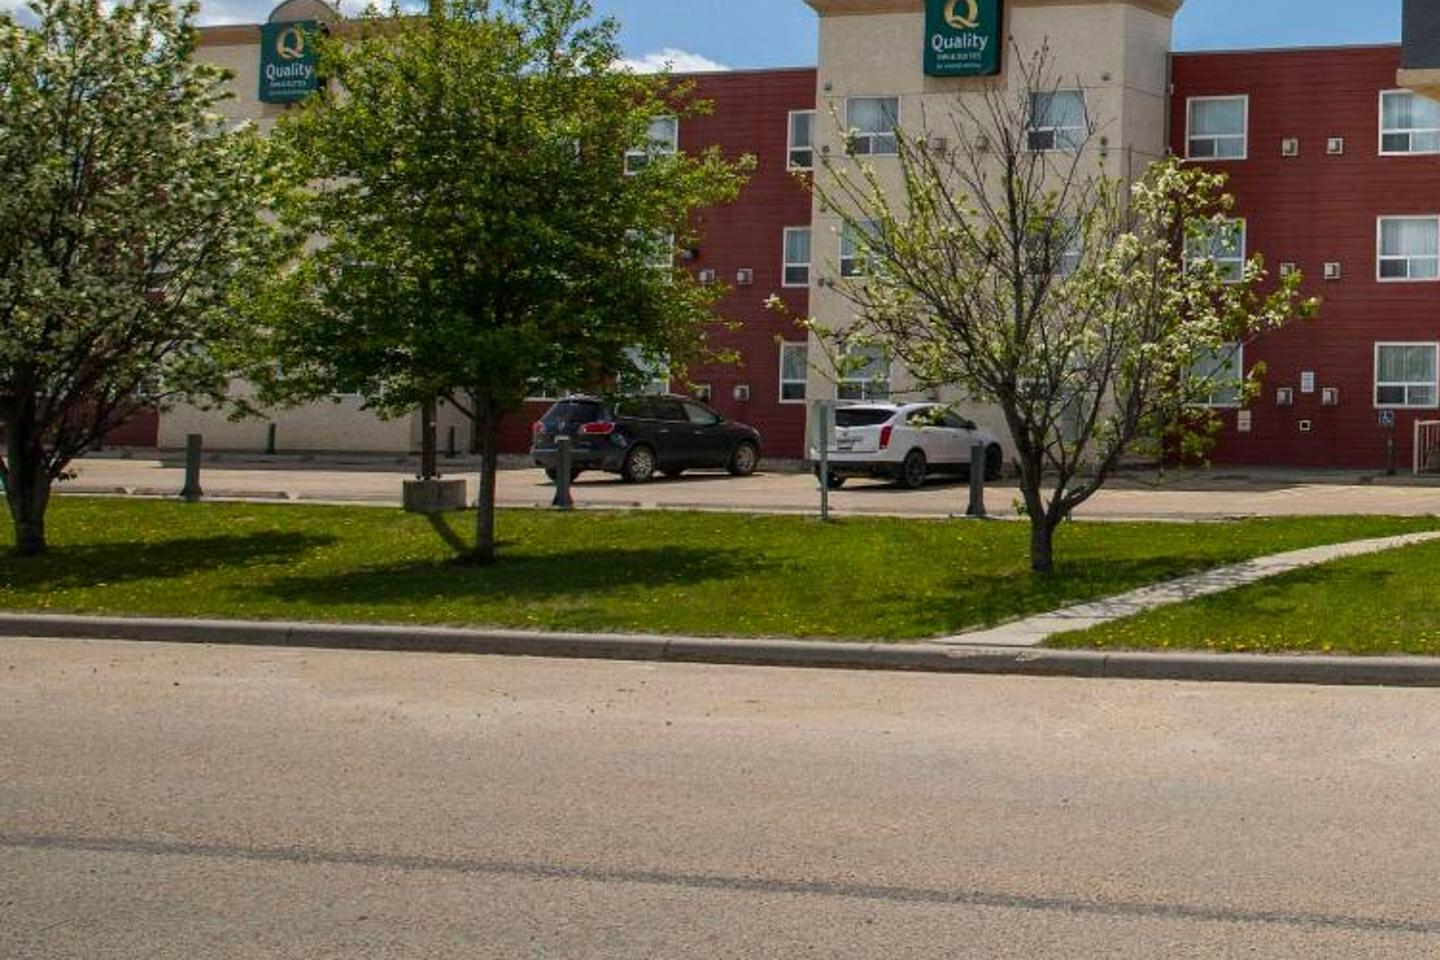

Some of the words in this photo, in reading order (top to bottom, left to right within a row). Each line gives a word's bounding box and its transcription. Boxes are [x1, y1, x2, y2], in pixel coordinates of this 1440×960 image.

[276, 27, 305, 59] Q
[931, 33, 988, 52] Quality
[265, 62, 312, 81] Quality
